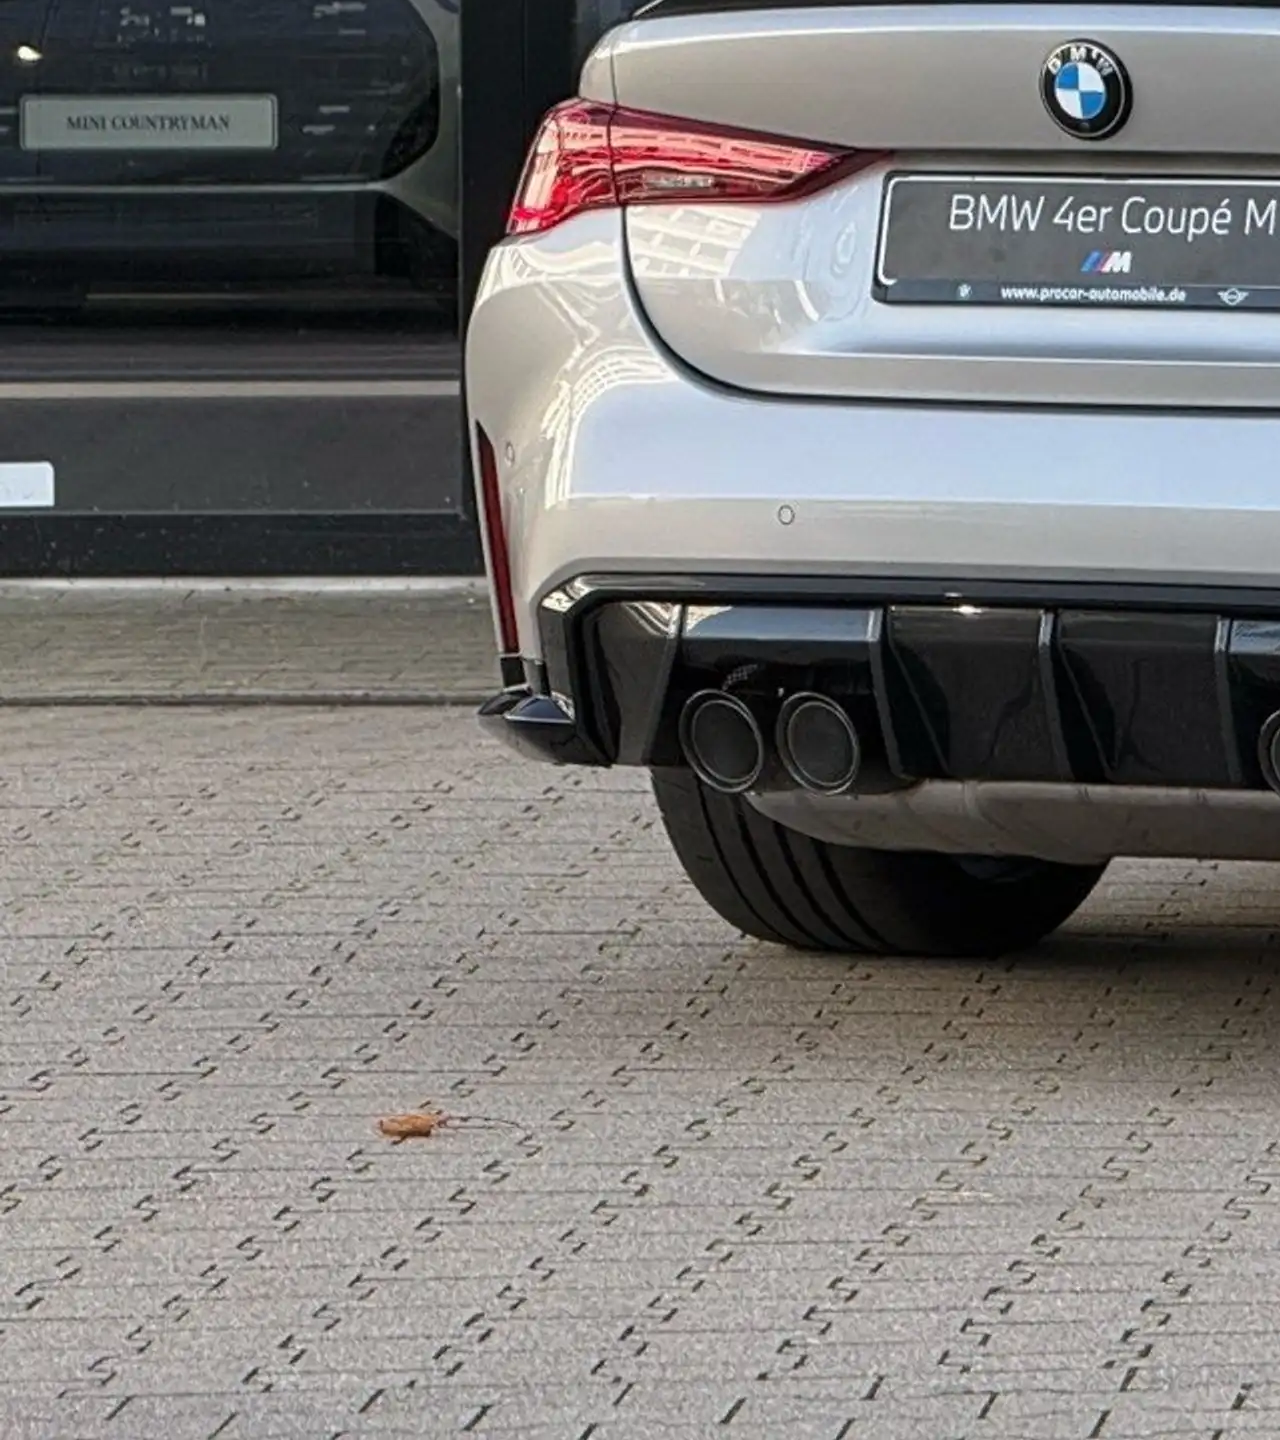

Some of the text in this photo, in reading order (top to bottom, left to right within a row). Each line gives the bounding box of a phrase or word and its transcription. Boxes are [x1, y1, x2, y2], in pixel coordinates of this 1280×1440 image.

[1047, 45, 1115, 77] BMW
[66, 115, 230, 131] MINI COUNTRYMAN
[949, 194, 1277, 242] BMW 4er Coupé M
[1001, 286, 1187, 303] www.procar-automobile.de
